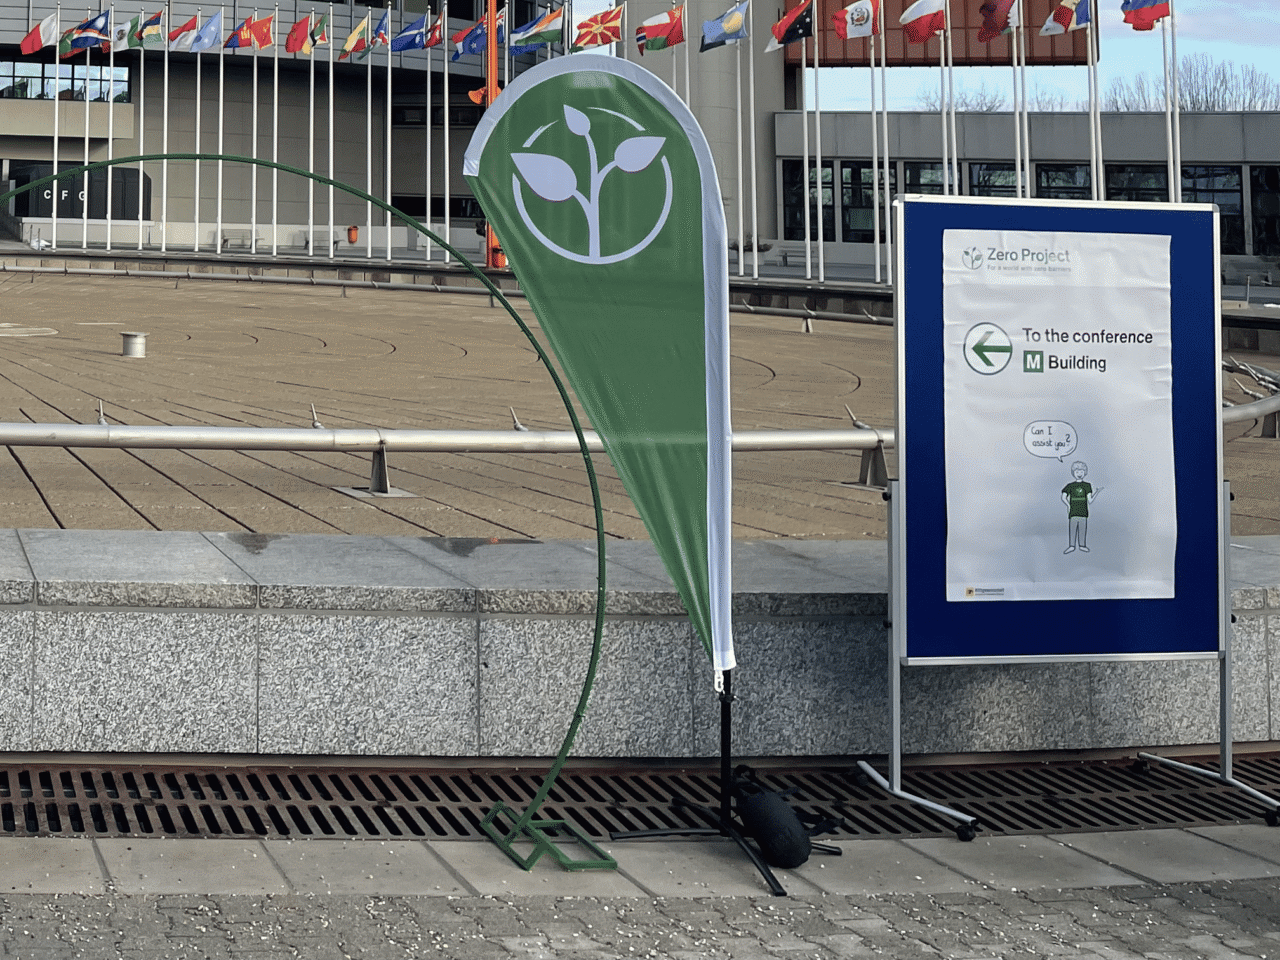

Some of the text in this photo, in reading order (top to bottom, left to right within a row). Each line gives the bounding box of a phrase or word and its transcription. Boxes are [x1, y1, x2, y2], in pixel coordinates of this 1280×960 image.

[44, 190, 52, 200] C
[62, 190, 68, 200] F
[987, 247, 1070, 264] Zero Project
[1022, 328, 1153, 344] To the conference
[1026, 354, 1107, 373] M Building
[1031, 426, 1053, 435] Can I
[1032, 437, 1053, 447] assist
